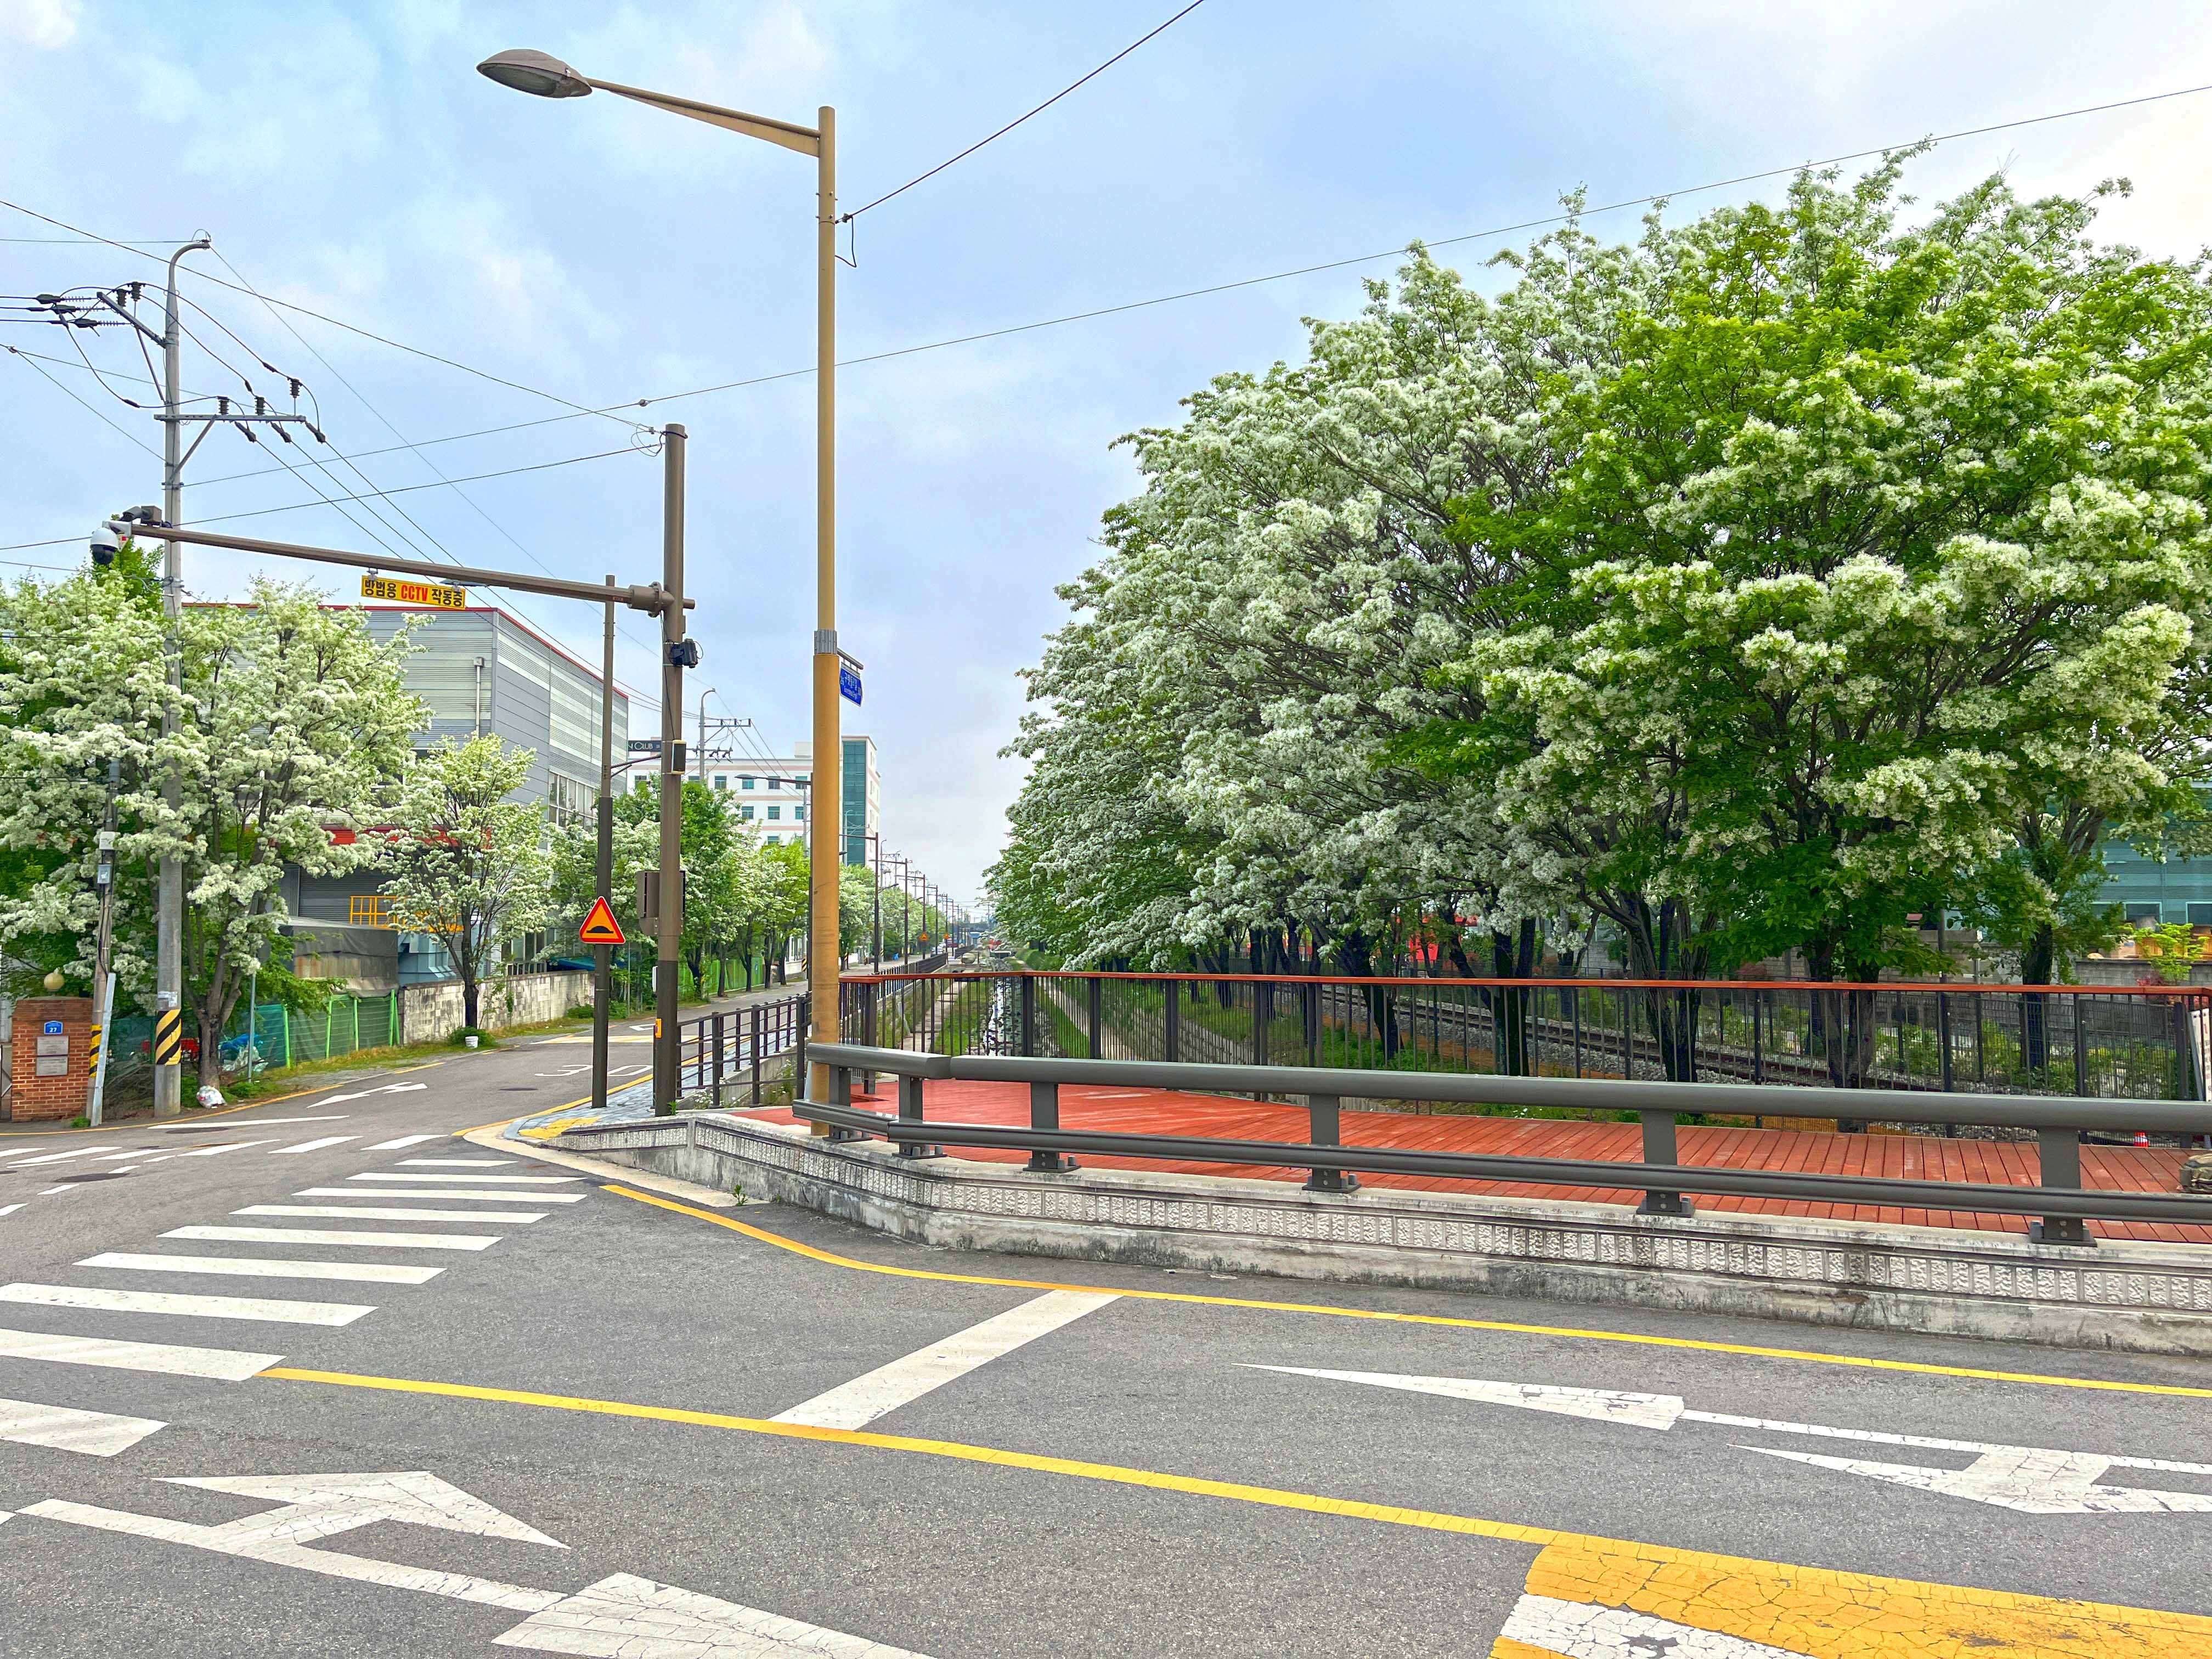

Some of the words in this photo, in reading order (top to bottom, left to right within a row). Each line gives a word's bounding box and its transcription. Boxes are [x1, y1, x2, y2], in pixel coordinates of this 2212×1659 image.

[364, 579, 397, 599] 방범용
[401, 584, 428, 602] CCTV
[432, 588, 462, 607] 작동중
[634, 741, 653, 750] CLUB
